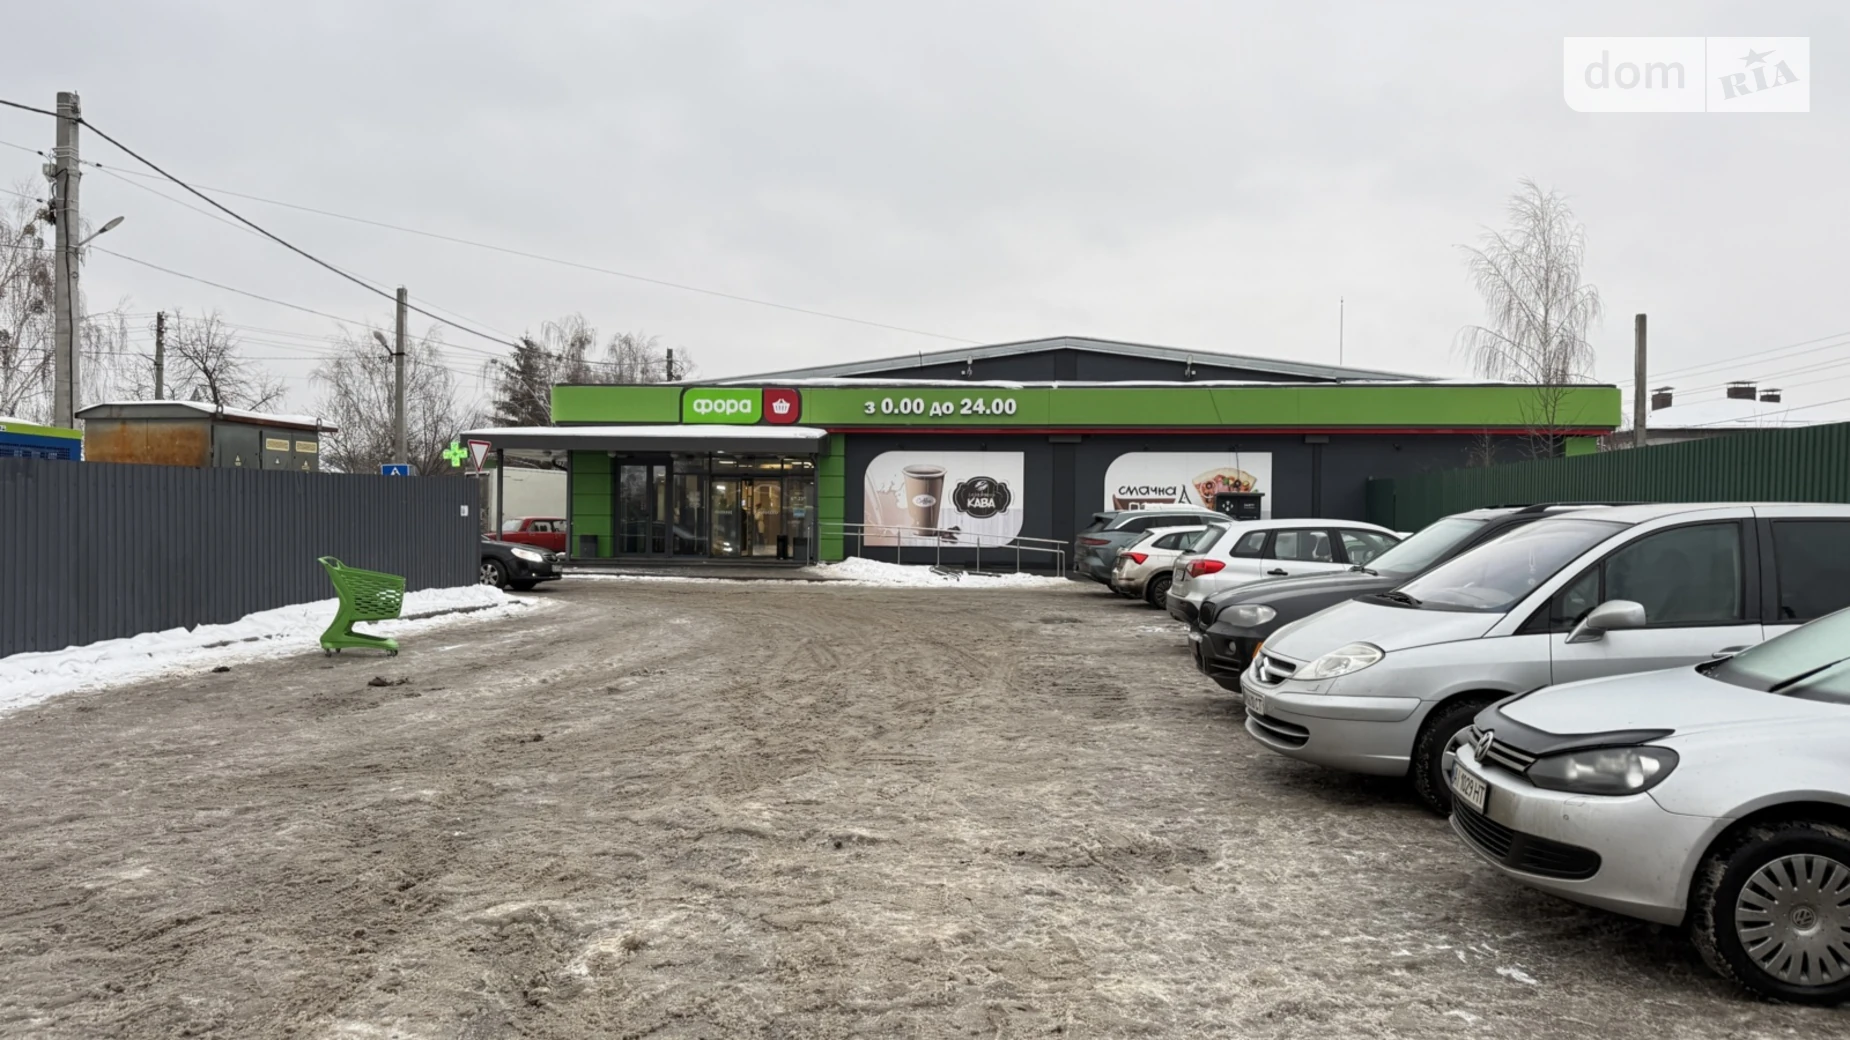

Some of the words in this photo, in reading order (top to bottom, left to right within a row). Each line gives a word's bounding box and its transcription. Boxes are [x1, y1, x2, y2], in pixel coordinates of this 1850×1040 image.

[693, 398, 752, 415] фора
[881, 398, 925, 415] 0.00
[929, 401, 955, 416] до
[959, 398, 1017, 415] 24.00
[1118, 485, 1177, 496] смачна
[967, 497, 996, 508] КАВА
[1473, 782, 1486, 806] HT
